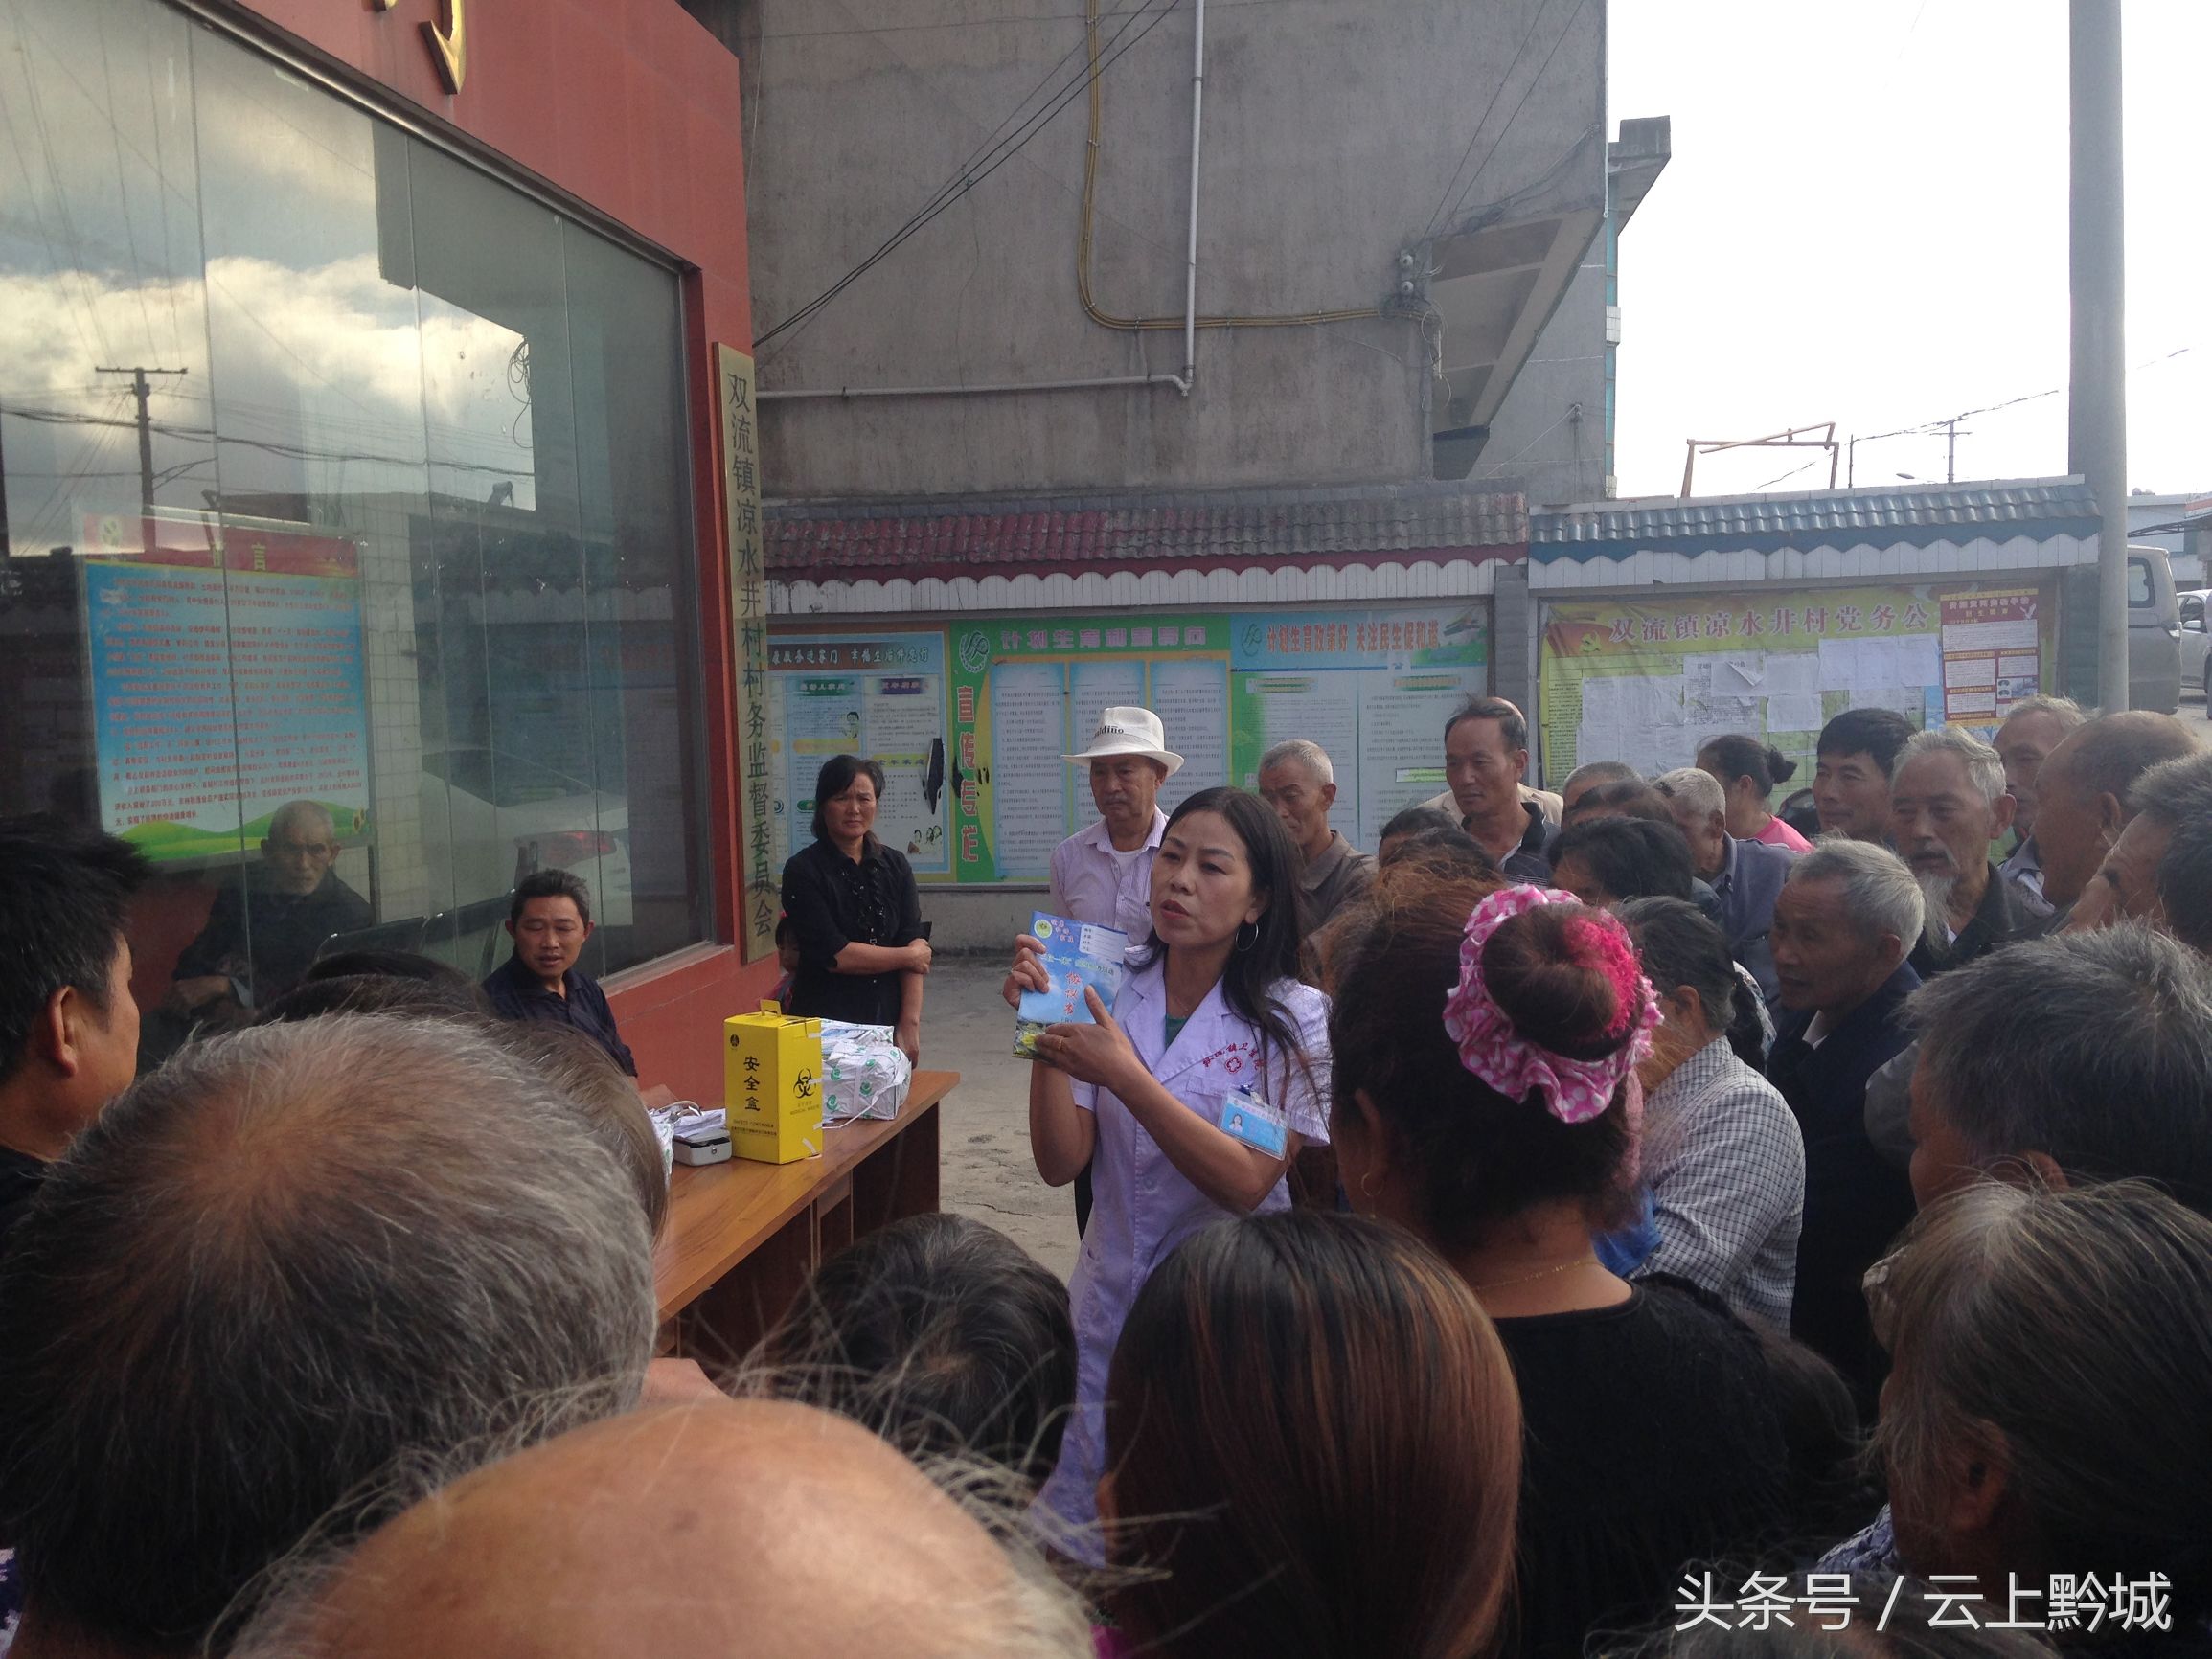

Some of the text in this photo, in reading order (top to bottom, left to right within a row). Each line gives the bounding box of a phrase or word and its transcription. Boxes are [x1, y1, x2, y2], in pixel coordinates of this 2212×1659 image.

[1266, 624, 1349, 653] 计划生育政策好
[1608, 603, 1942, 643] 双流镇凉水井村党务公
[727, 373, 774, 938] 双流镇凉水井村村务监督委员会
[743, 1056, 760, 1111] 安全盒
